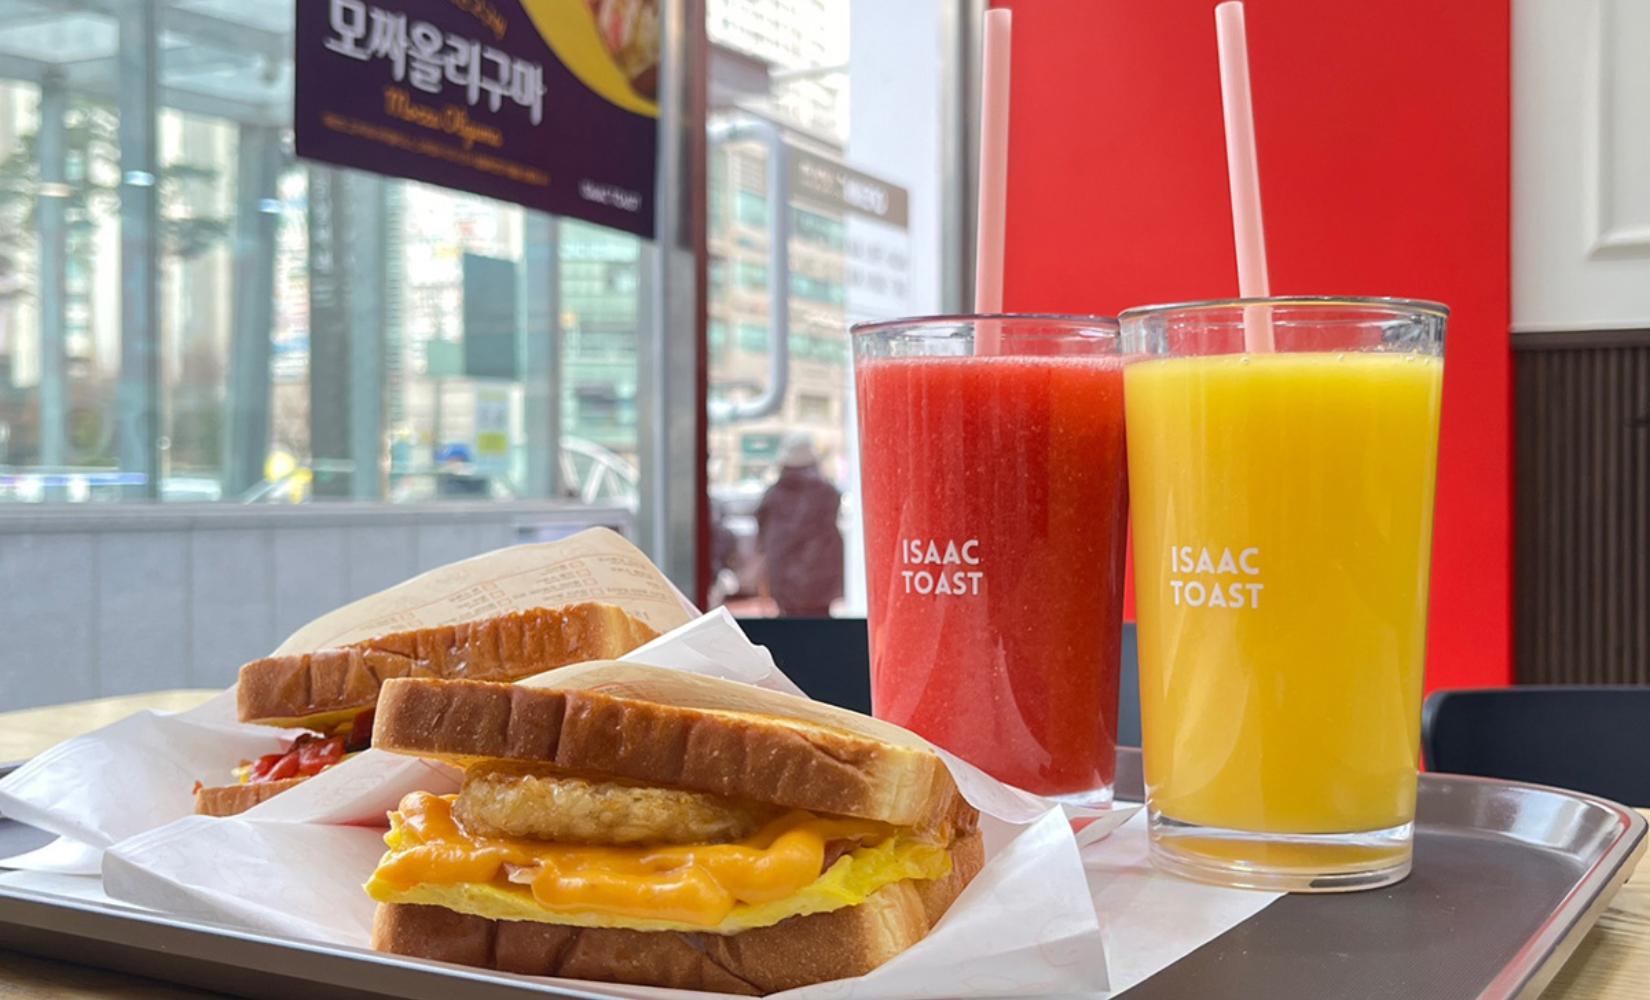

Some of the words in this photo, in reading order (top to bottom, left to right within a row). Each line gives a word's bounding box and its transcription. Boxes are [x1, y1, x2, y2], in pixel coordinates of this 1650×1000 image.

[323, 0, 547, 126] 모짜올리구마
[903, 539, 980, 566] ISAAC
[1171, 545, 1260, 575] ISAAC
[901, 570, 984, 595] TOAST
[1170, 580, 1264, 609] TOAST
